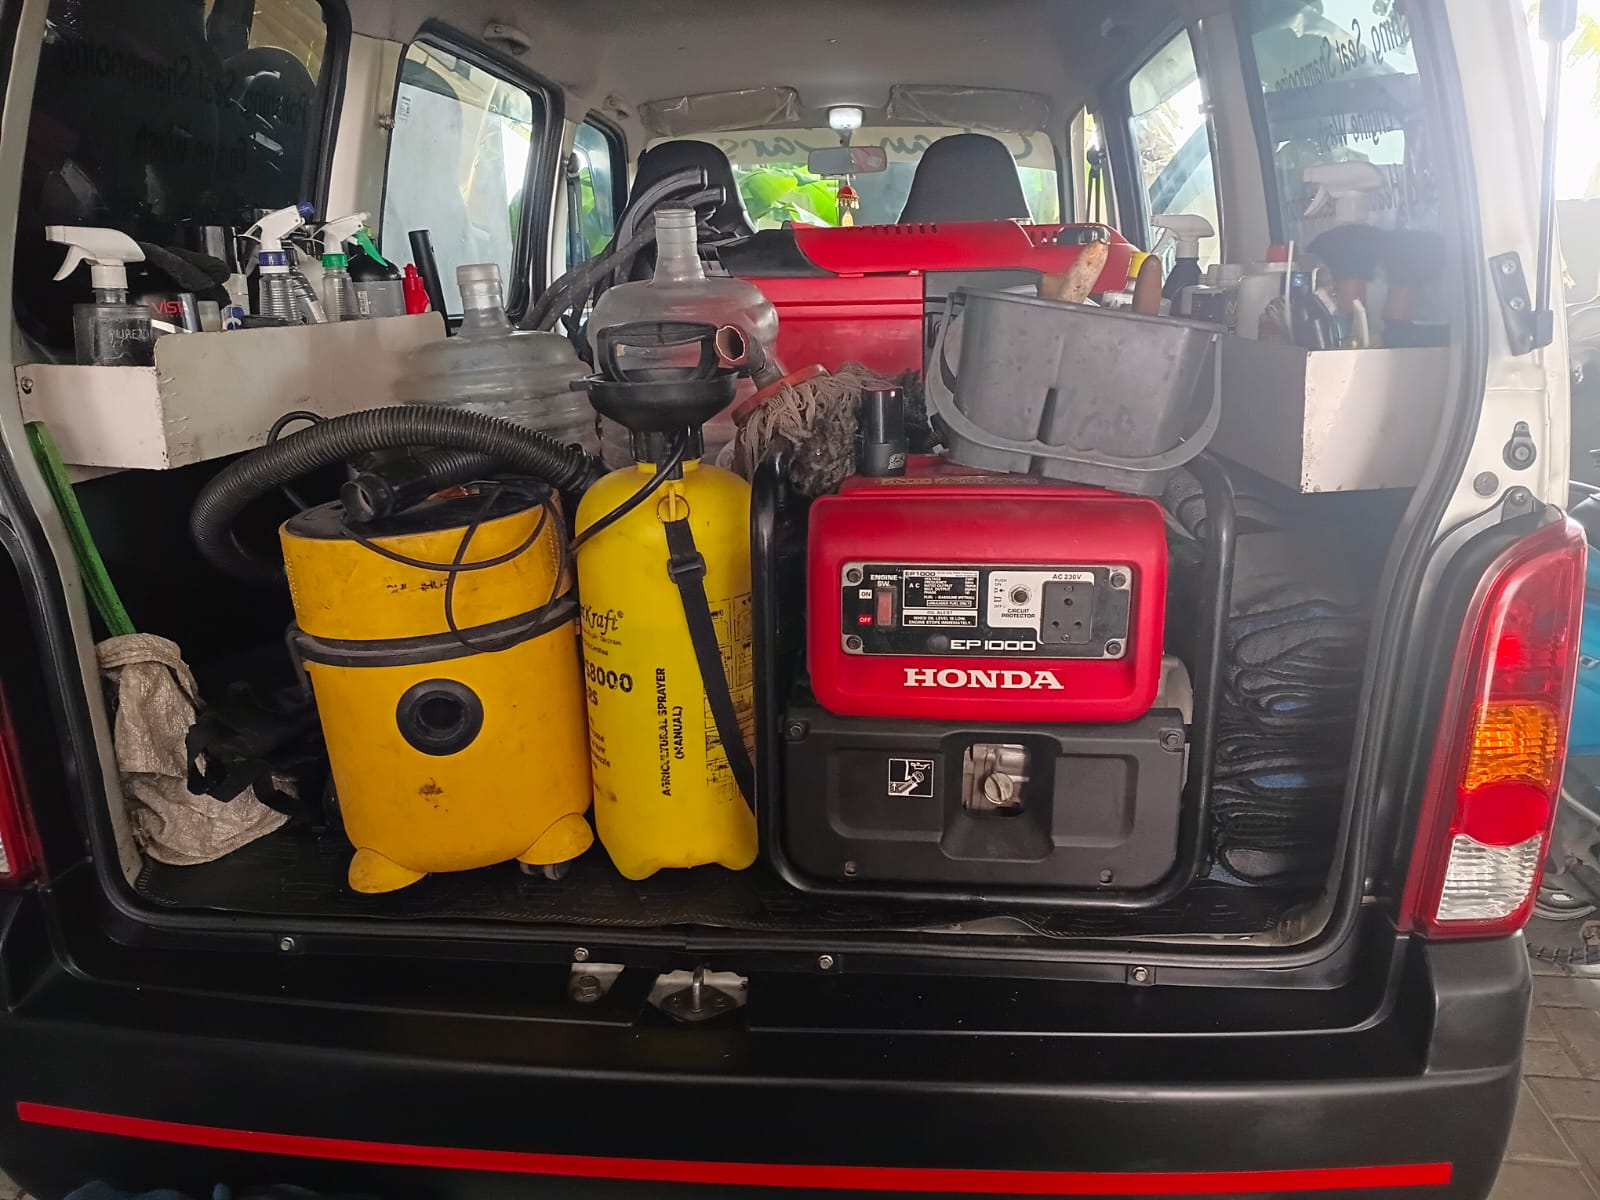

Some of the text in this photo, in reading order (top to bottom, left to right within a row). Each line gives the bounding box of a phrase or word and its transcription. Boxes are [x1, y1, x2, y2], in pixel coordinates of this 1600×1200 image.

[950, 640, 1037, 652] EP1000
[655, 667, 668, 716] SPRAYER
[903, 668, 1065, 690] HONDA
[672, 705, 685, 760] (MANUAL)
